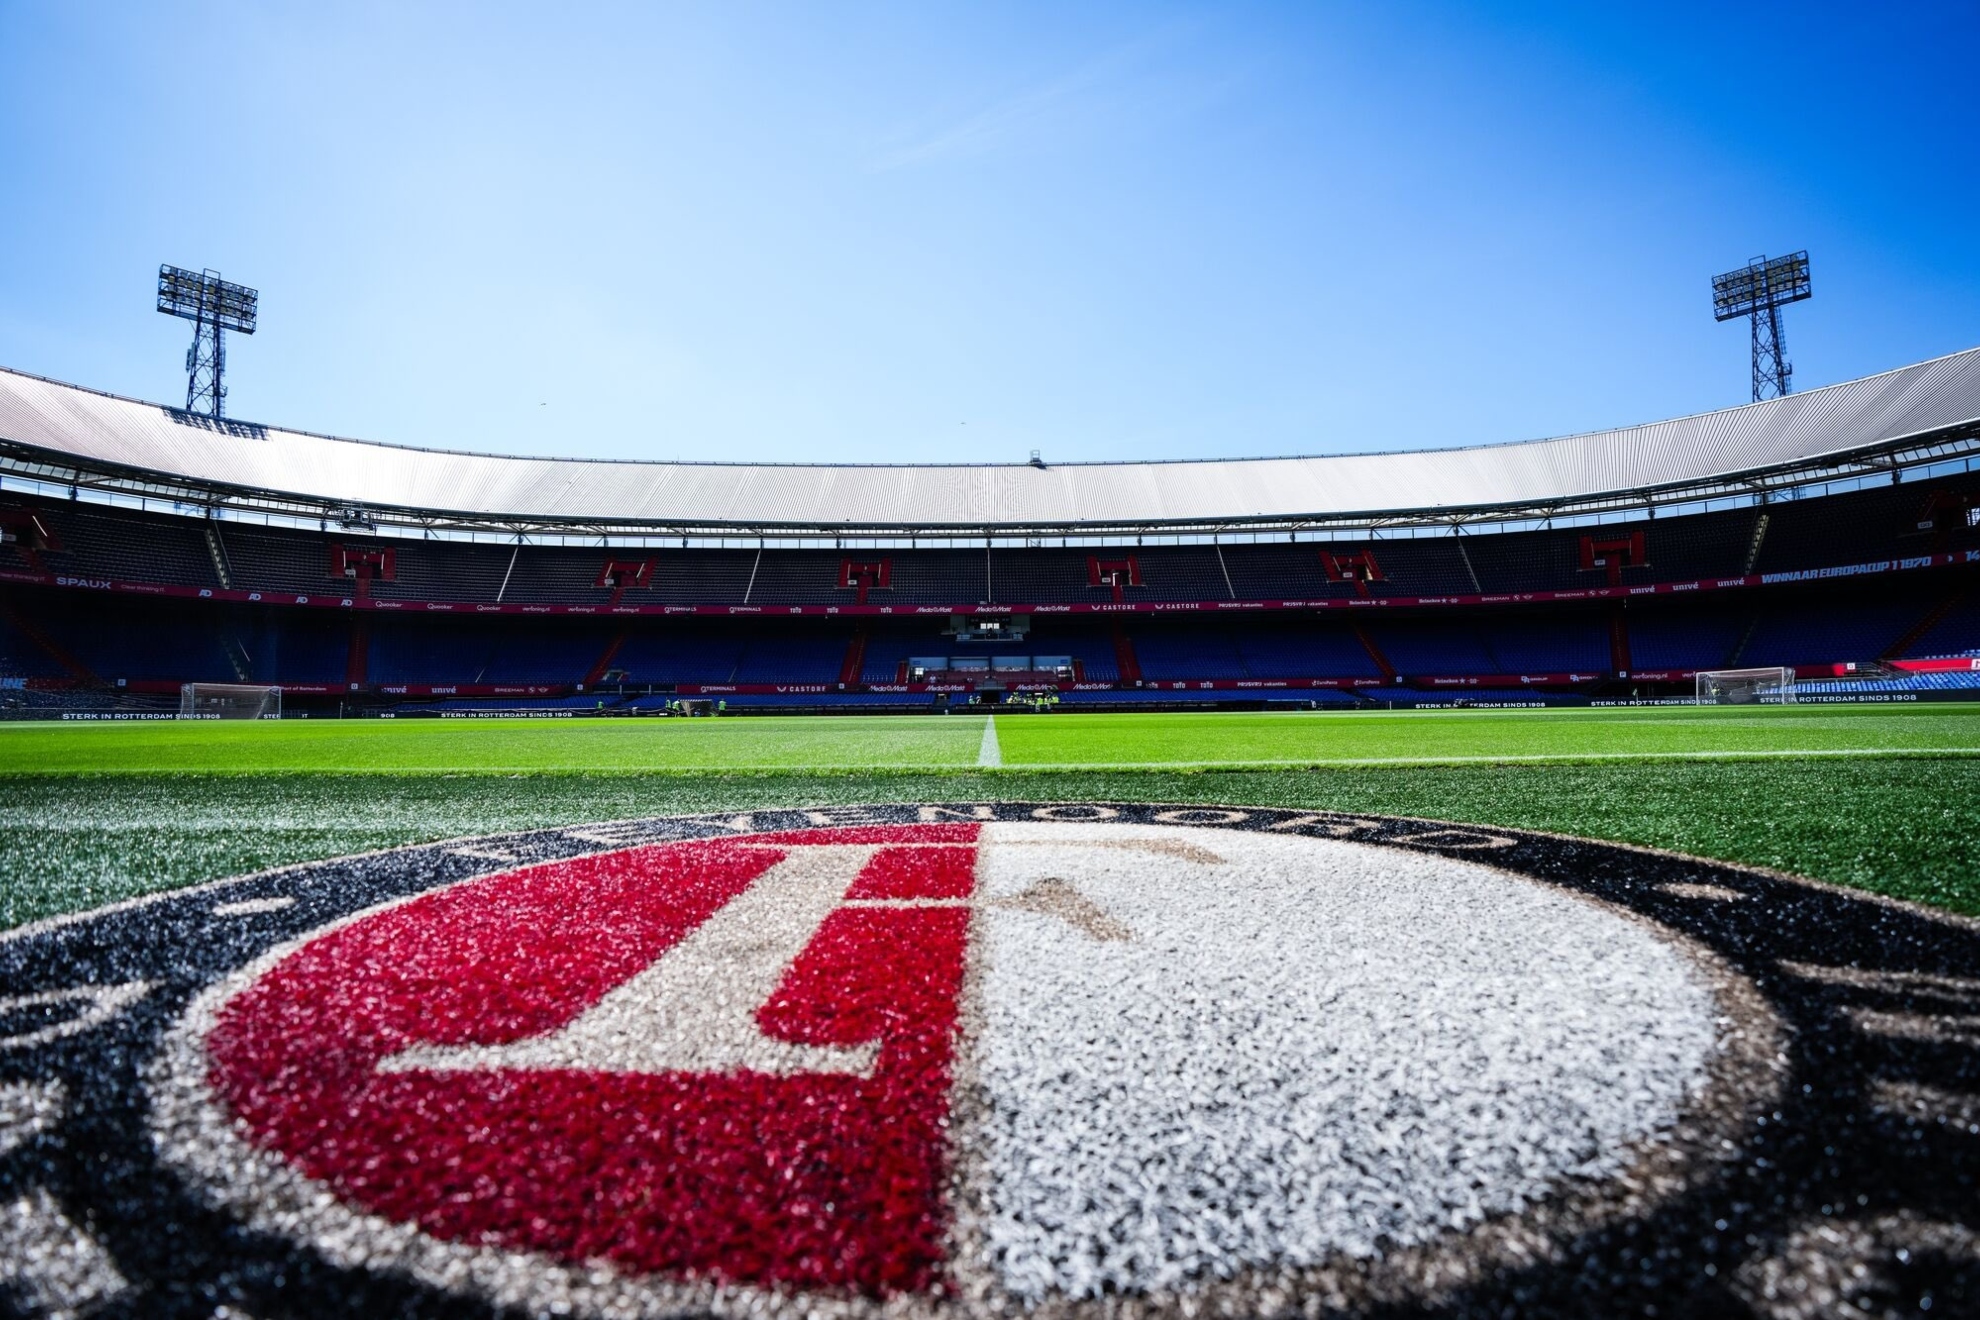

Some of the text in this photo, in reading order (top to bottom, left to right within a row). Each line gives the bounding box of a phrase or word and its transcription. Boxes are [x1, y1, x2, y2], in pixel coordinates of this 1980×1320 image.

[1761, 569, 1818, 584] WINNAAR
[56, 577, 112, 589] SPAUX
[1673, 582, 1698, 590] univé
[1718, 578, 1744, 586] univé
[1630, 585, 1655, 594] univé
